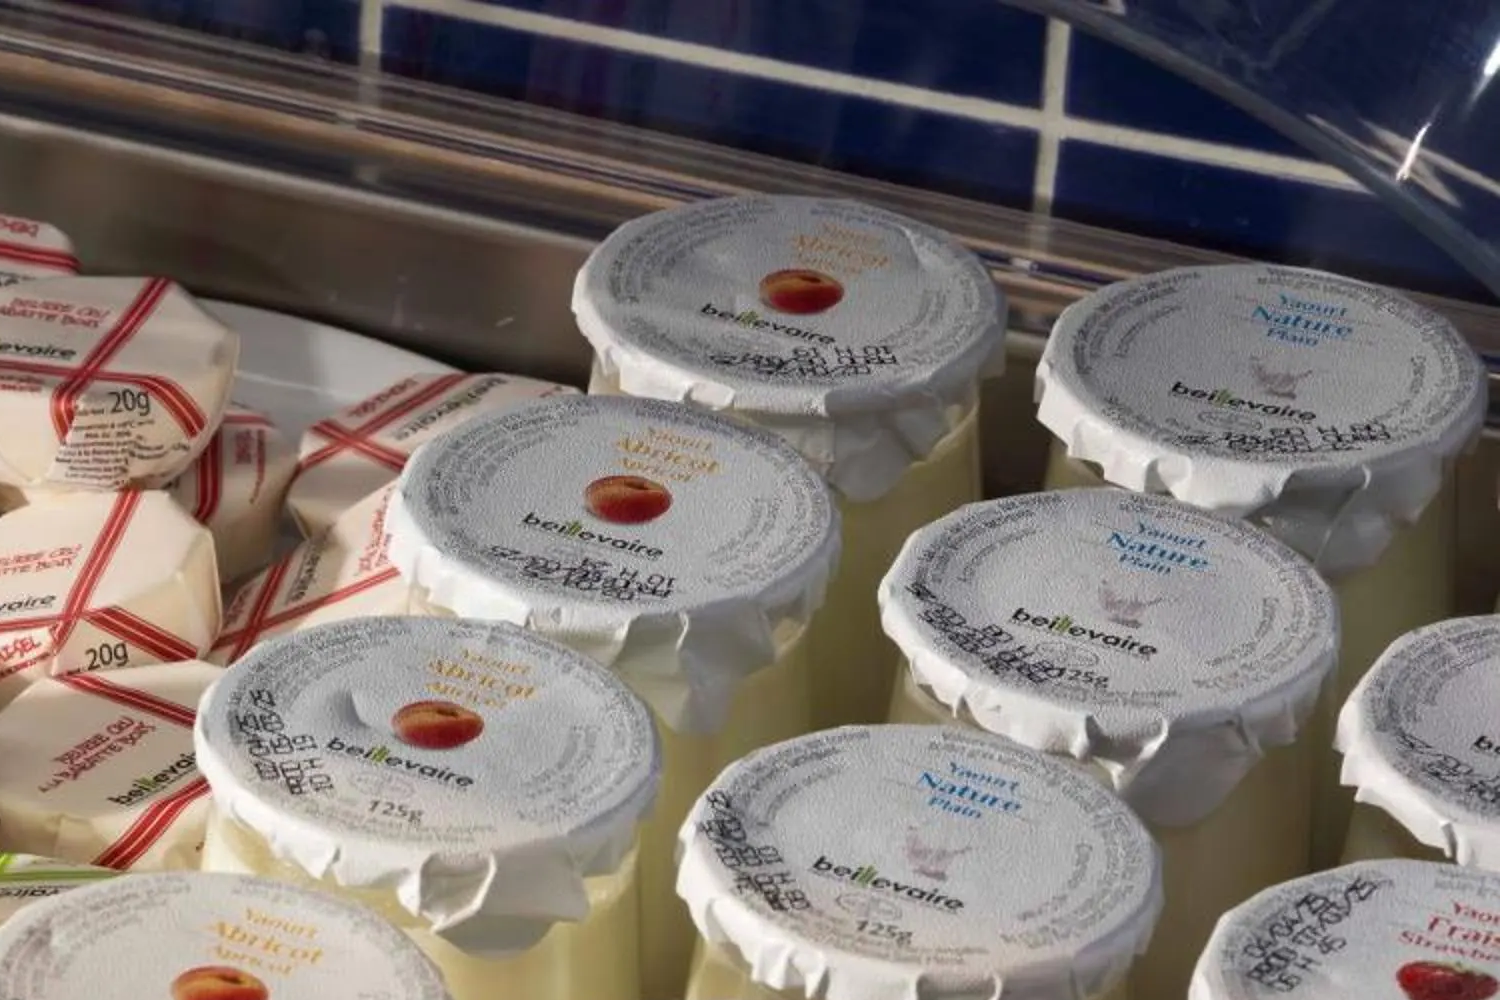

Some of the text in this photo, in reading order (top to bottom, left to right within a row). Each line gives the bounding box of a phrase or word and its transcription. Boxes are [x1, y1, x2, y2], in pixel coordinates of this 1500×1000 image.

[700, 302, 838, 346] beillevaire
[1251, 304, 1355, 340] Nature
[108, 388, 151, 416] 20g
[1171, 381, 1317, 423] beillevaire
[521, 511, 665, 559] beillevaire
[1106, 531, 1210, 572] Nature
[1118, 553, 1173, 576] Plain
[1011, 606, 1159, 663] beillevaire
[85, 642, 130, 672] 20g
[106, 751, 198, 805] beillevai
[326, 736, 475, 789] beillevaire
[368, 799, 425, 823] 125g
[915, 771, 1023, 815] Nature
[928, 795, 983, 819] Plain
[810, 854, 965, 912] beillevaire
[242, 906, 322, 941] Yaourt
[855, 918, 914, 944] 125g
[1427, 915, 1500, 945] Frais
[1453, 901, 1500, 925] Yao
